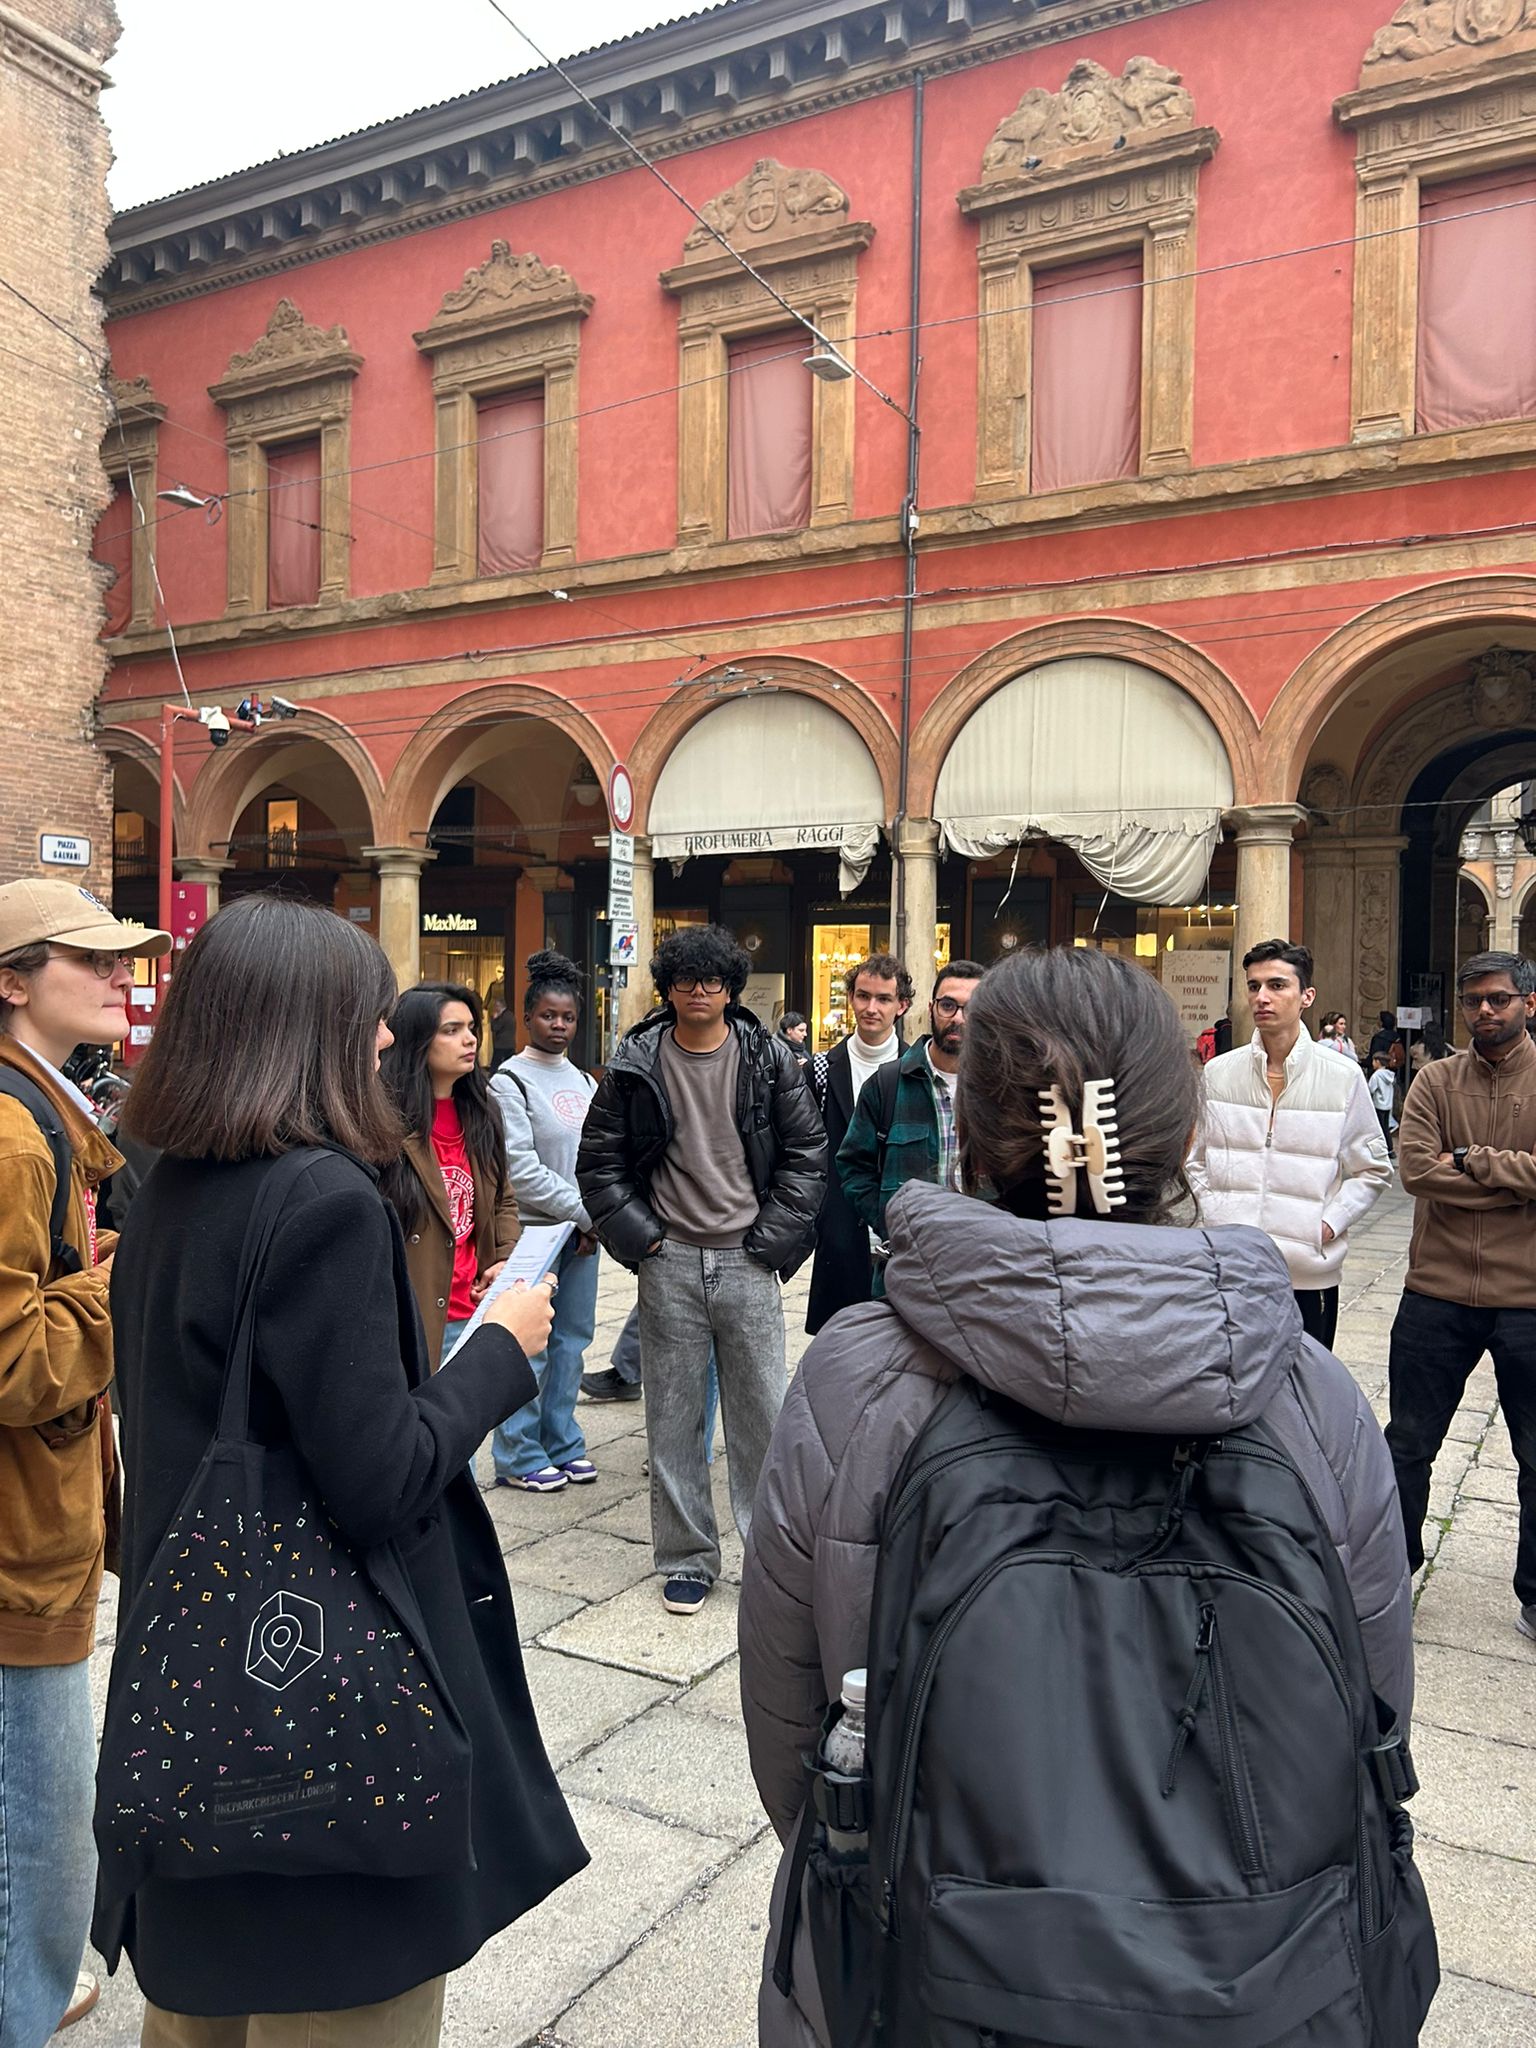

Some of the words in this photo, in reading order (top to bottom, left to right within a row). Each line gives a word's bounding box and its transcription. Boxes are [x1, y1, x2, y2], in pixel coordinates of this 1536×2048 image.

[684, 830, 773, 851] PROFUMERIA
[796, 826, 844, 844] RAGGI
[57, 840, 76, 849] PIAZZA
[53, 850, 81, 860] GALVANI
[423, 913, 478, 931] MaxMara
[1171, 975, 1220, 984] LIQUIDAZIONE
[1183, 986, 1208, 996] TOTALE
